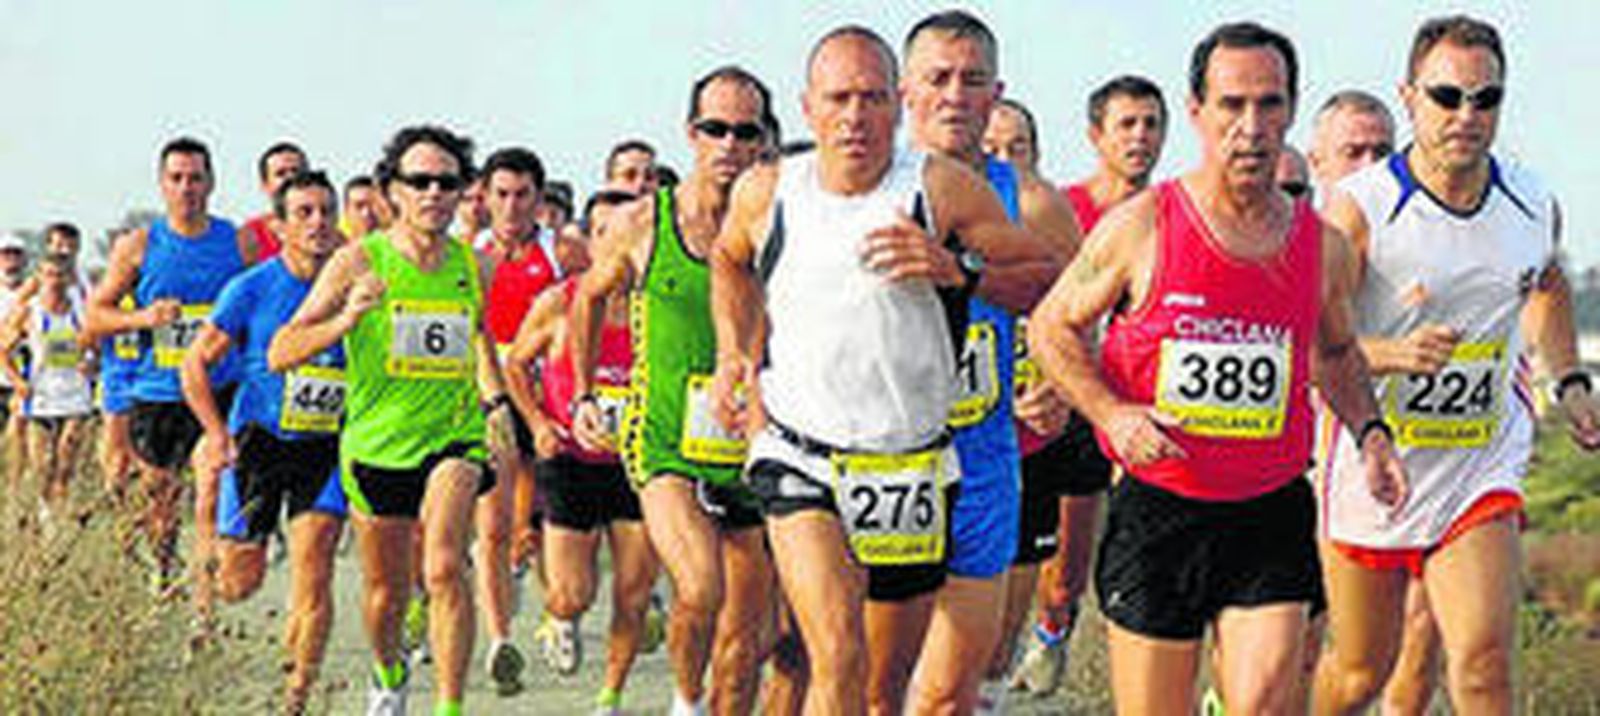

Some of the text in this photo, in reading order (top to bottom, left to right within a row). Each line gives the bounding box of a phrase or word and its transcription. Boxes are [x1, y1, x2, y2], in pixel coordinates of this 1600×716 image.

[425, 321, 446, 355] 6
[1178, 352, 1276, 402] 389
[1408, 371, 1493, 414] 224
[851, 481, 934, 529] 275
